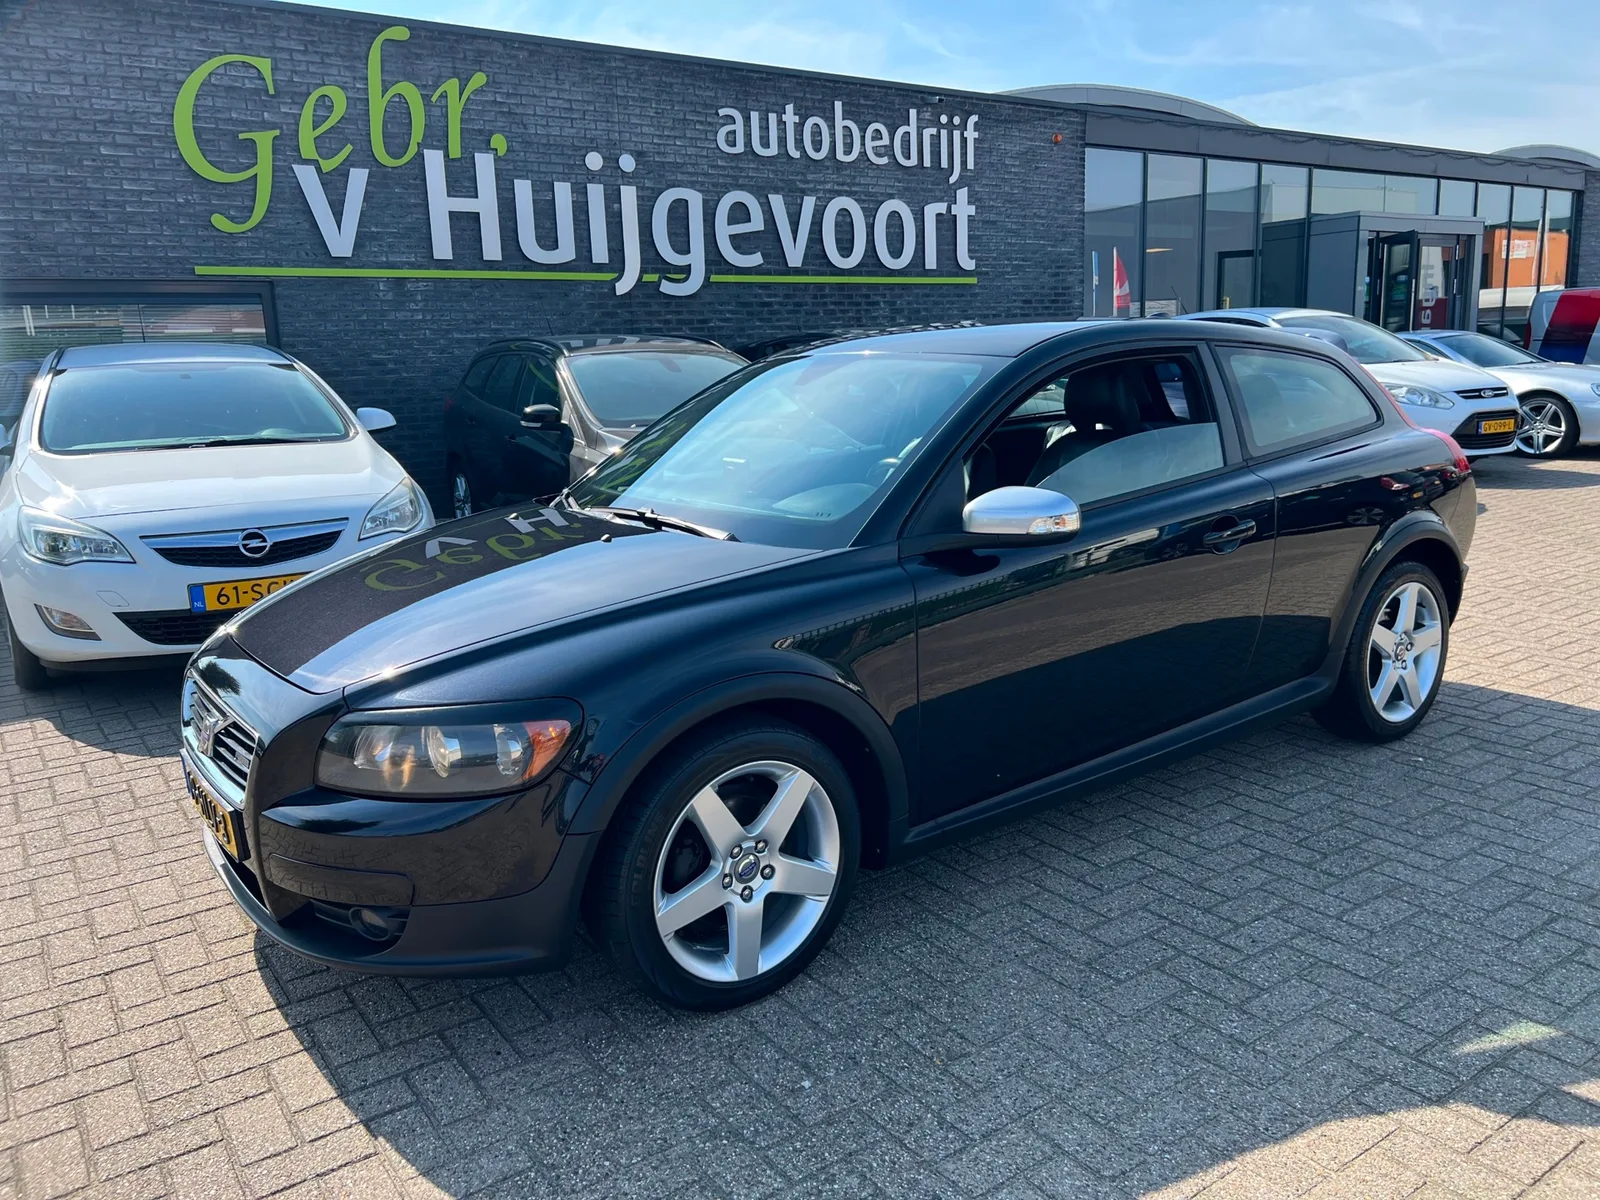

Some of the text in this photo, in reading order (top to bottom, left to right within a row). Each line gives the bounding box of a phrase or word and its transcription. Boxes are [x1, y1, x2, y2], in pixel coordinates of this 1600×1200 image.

[173, 26, 508, 234] Gebr.
[715, 100, 979, 185] autobedrijf
[423, 148, 977, 297] Huijgevoort
[216, 579, 293, 605] 61-SC
